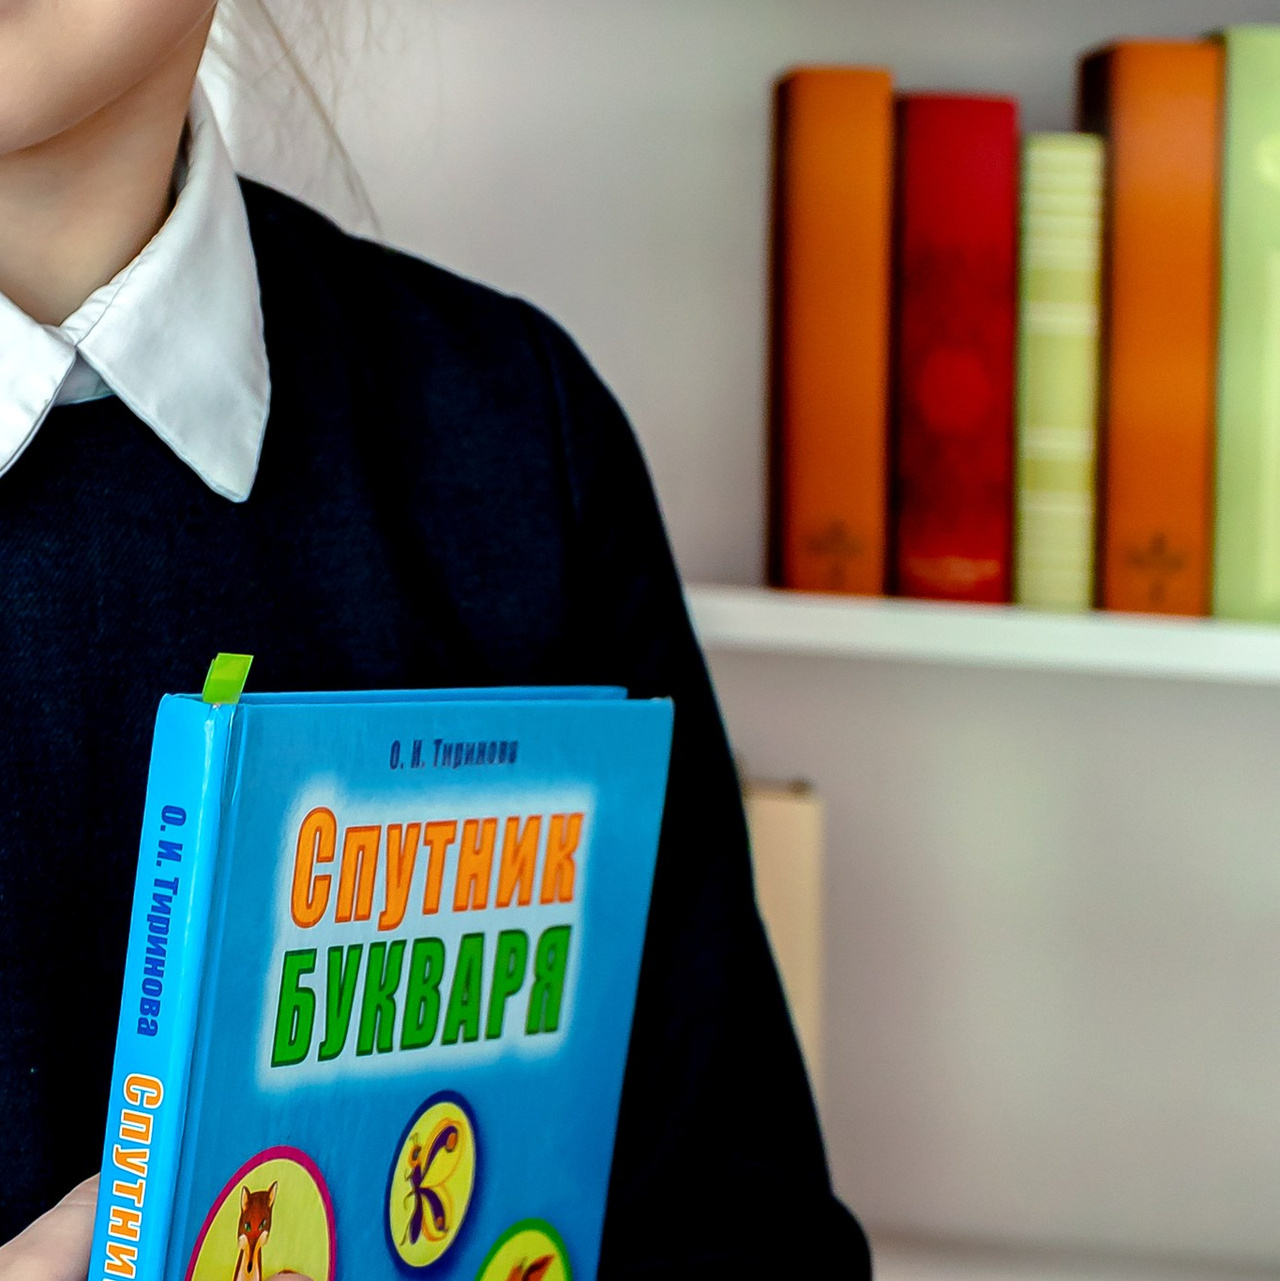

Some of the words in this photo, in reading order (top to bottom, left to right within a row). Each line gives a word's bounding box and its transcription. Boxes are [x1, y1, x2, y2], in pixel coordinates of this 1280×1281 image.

[389, 740, 404, 770] О.
[156, 839, 183, 867] И.
[160, 804, 187, 832] О.
[290, 806, 585, 932] Спутник
[136, 876, 180, 1037] Тиринова
[270, 924, 572, 1068] БУКВАРЯ
